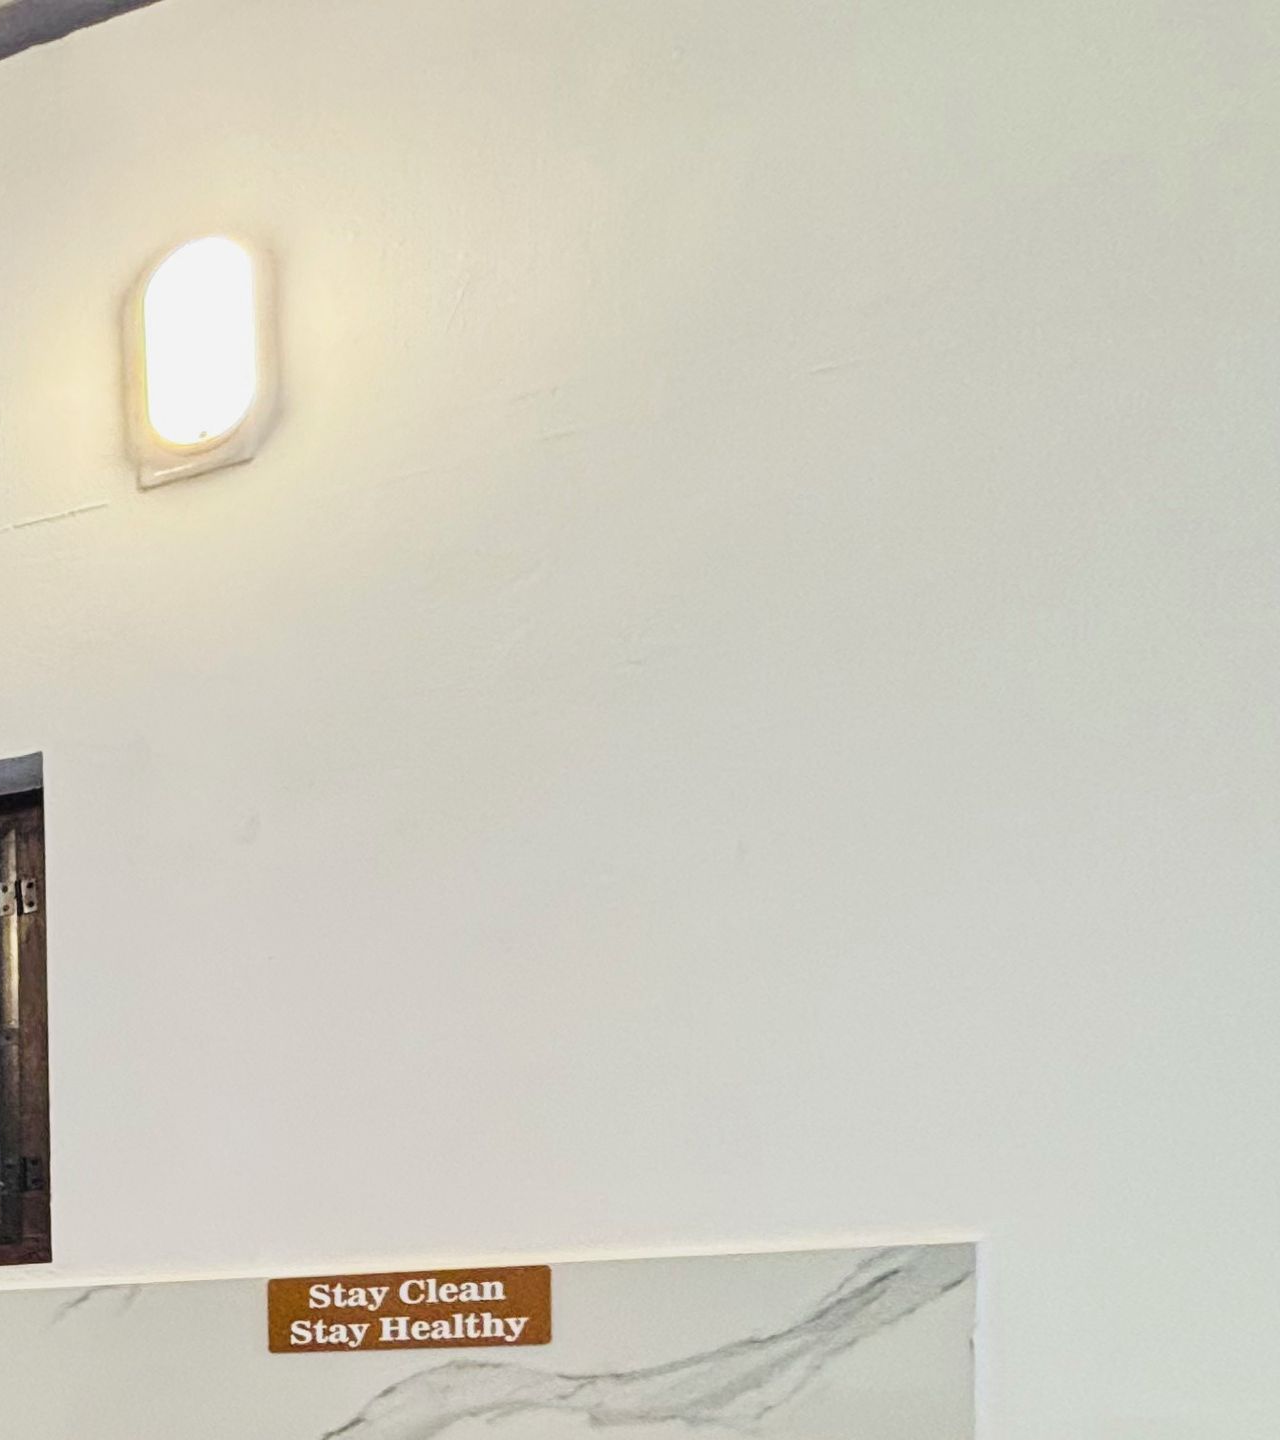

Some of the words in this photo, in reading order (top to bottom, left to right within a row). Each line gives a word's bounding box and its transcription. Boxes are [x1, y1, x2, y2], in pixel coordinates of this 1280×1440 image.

[308, 1283, 390, 1311] Stay
[399, 1278, 506, 1305] Clean
[290, 1319, 370, 1348] Stay
[379, 1312, 529, 1342] Healthy
